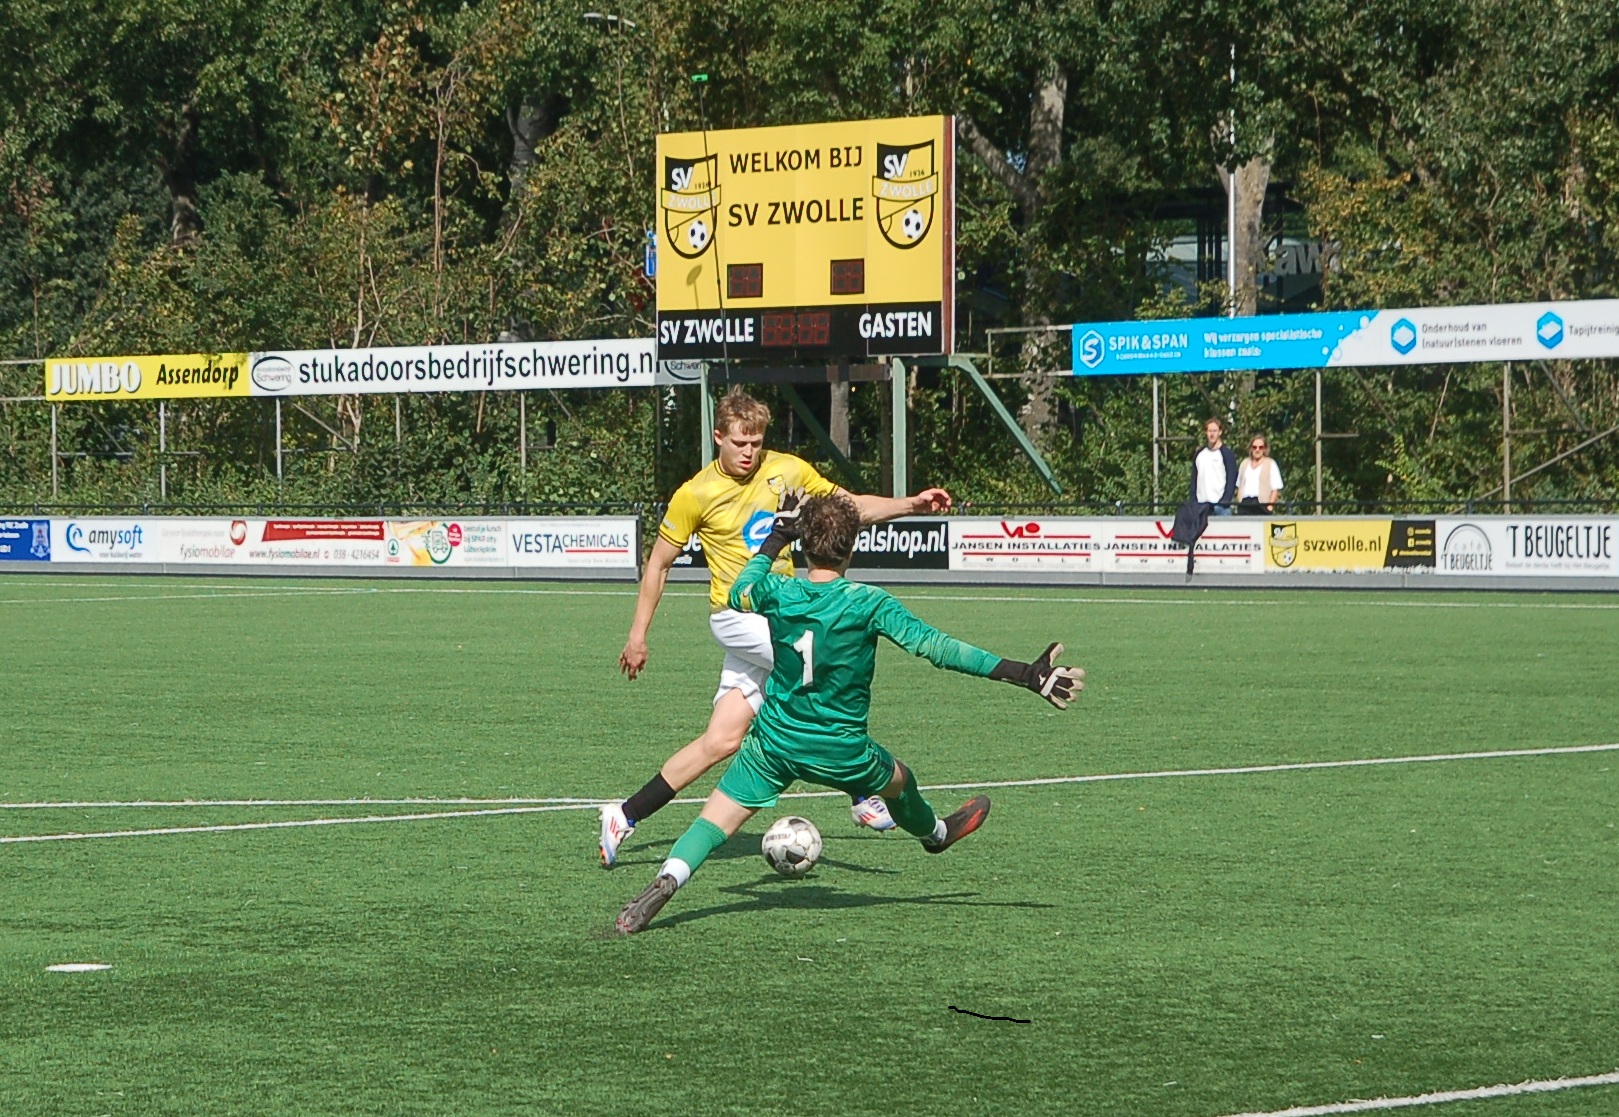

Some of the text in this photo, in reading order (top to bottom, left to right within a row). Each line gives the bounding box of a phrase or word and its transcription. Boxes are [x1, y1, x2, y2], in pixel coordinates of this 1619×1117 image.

[729, 146, 863, 174] WELKOM BIJ
[883, 153, 909, 178] SV
[671, 167, 694, 191] SV
[880, 179, 933, 198] ZWOLLE
[728, 197, 864, 227] SV ZWOLLE
[660, 318, 754, 345] SV ZWOLLE
[859, 312, 932, 339] GASTEN
[1421, 322, 1487, 333] Onderhoud van
[1489, 334, 1523, 346] vloeren
[50, 362, 142, 395] JUMBO
[156, 360, 239, 390] Assendorp
[88, 524, 143, 550] amysoft
[952, 542, 1101, 550] JANSEN INSTALLATIES
[1104, 543, 1262, 551] JANSEN INSALLATIES
[1303, 536, 1382, 552] svzwolle.nl
[1506, 525, 1612, 558] 'T BEUGELTJE
[1450, 552, 1493, 570] BEUGELTJE
[793, 629, 815, 687] 1
